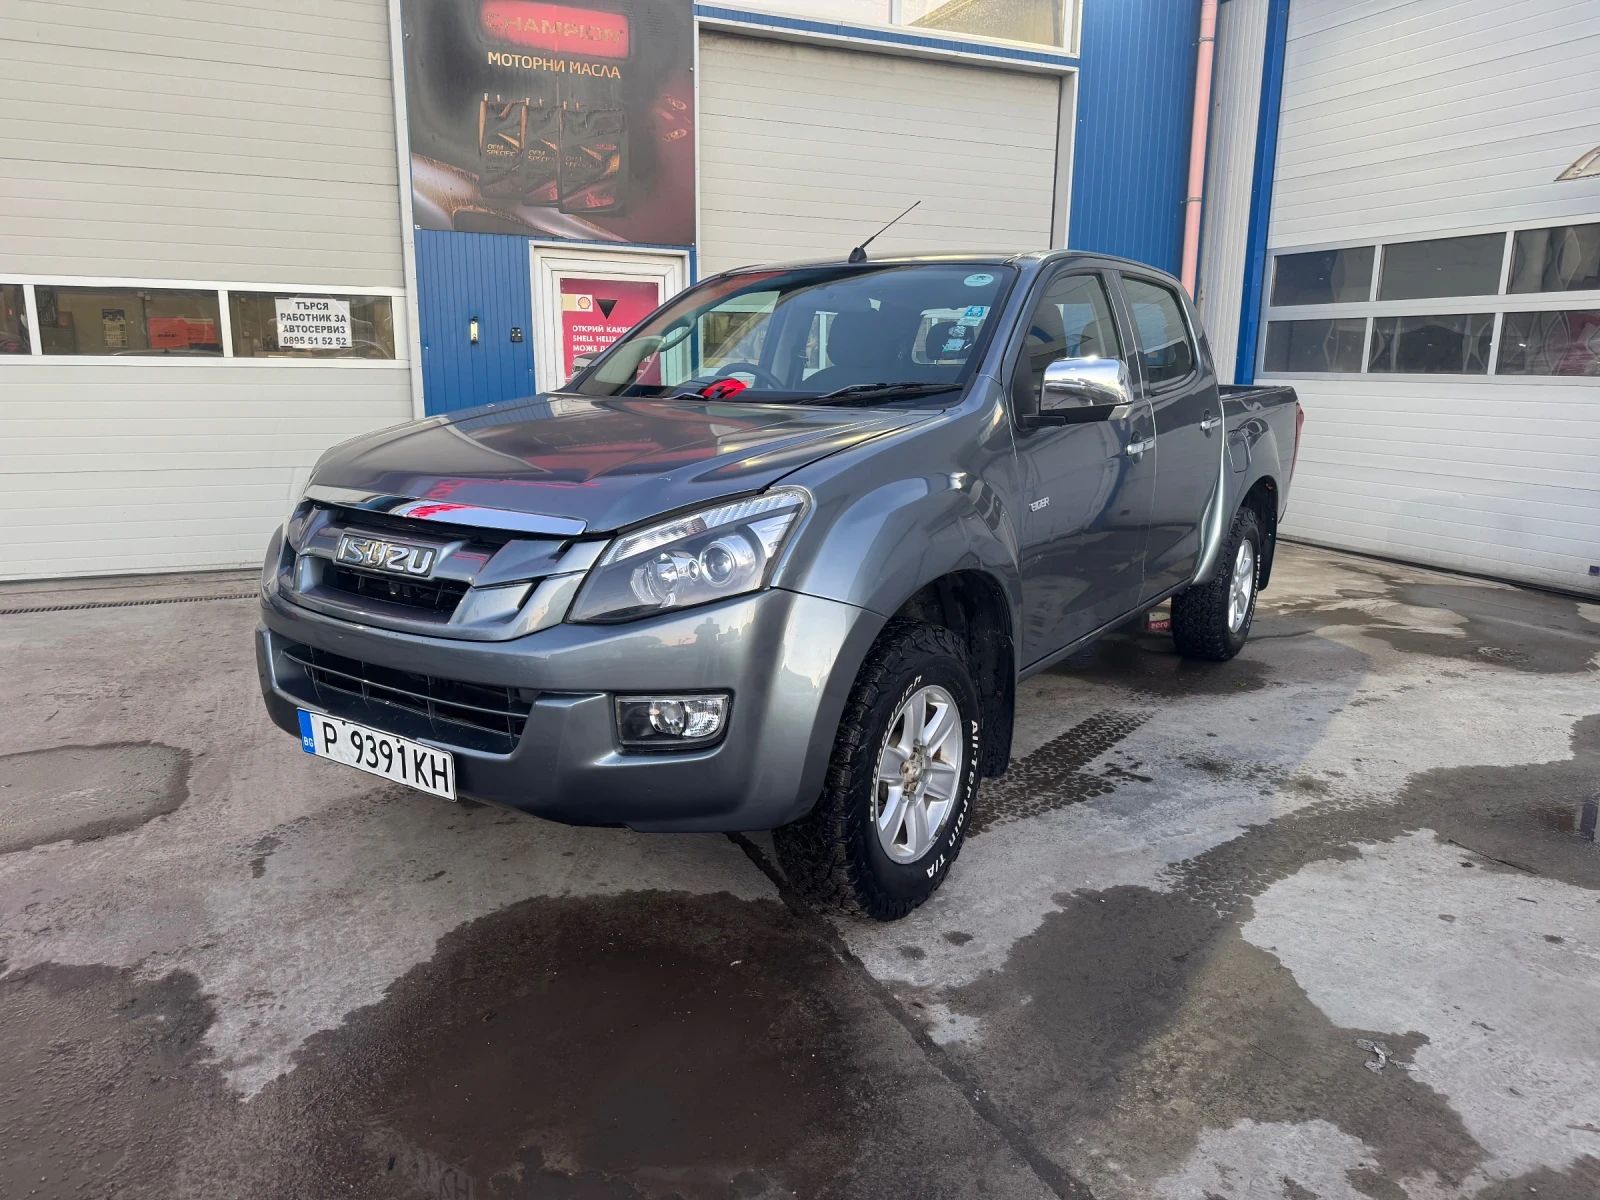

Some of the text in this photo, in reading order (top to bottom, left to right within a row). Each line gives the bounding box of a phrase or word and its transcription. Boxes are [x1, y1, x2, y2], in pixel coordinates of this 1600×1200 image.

[485, 11, 624, 43] CHAMPION
[487, 51, 621, 79] МОТОРНИ МАСЛА
[295, 301, 329, 311] ТЪРСЯ
[280, 313, 347, 323] РАБОТНИК ЗА
[283, 324, 346, 334] АВТОСЕРВИЗ
[572, 324, 604, 333] ОТКРИЙ
[283, 336, 347, 346] 0895 51 52 52
[596, 335, 617, 343] HELIX
[572, 344, 598, 352] МОЖЕ
[339, 536, 434, 575] ISUZU
[303, 736, 314, 748] BG
[322, 721, 339, 754] P
[926, 719, 980, 879] All-Terrain T/A
